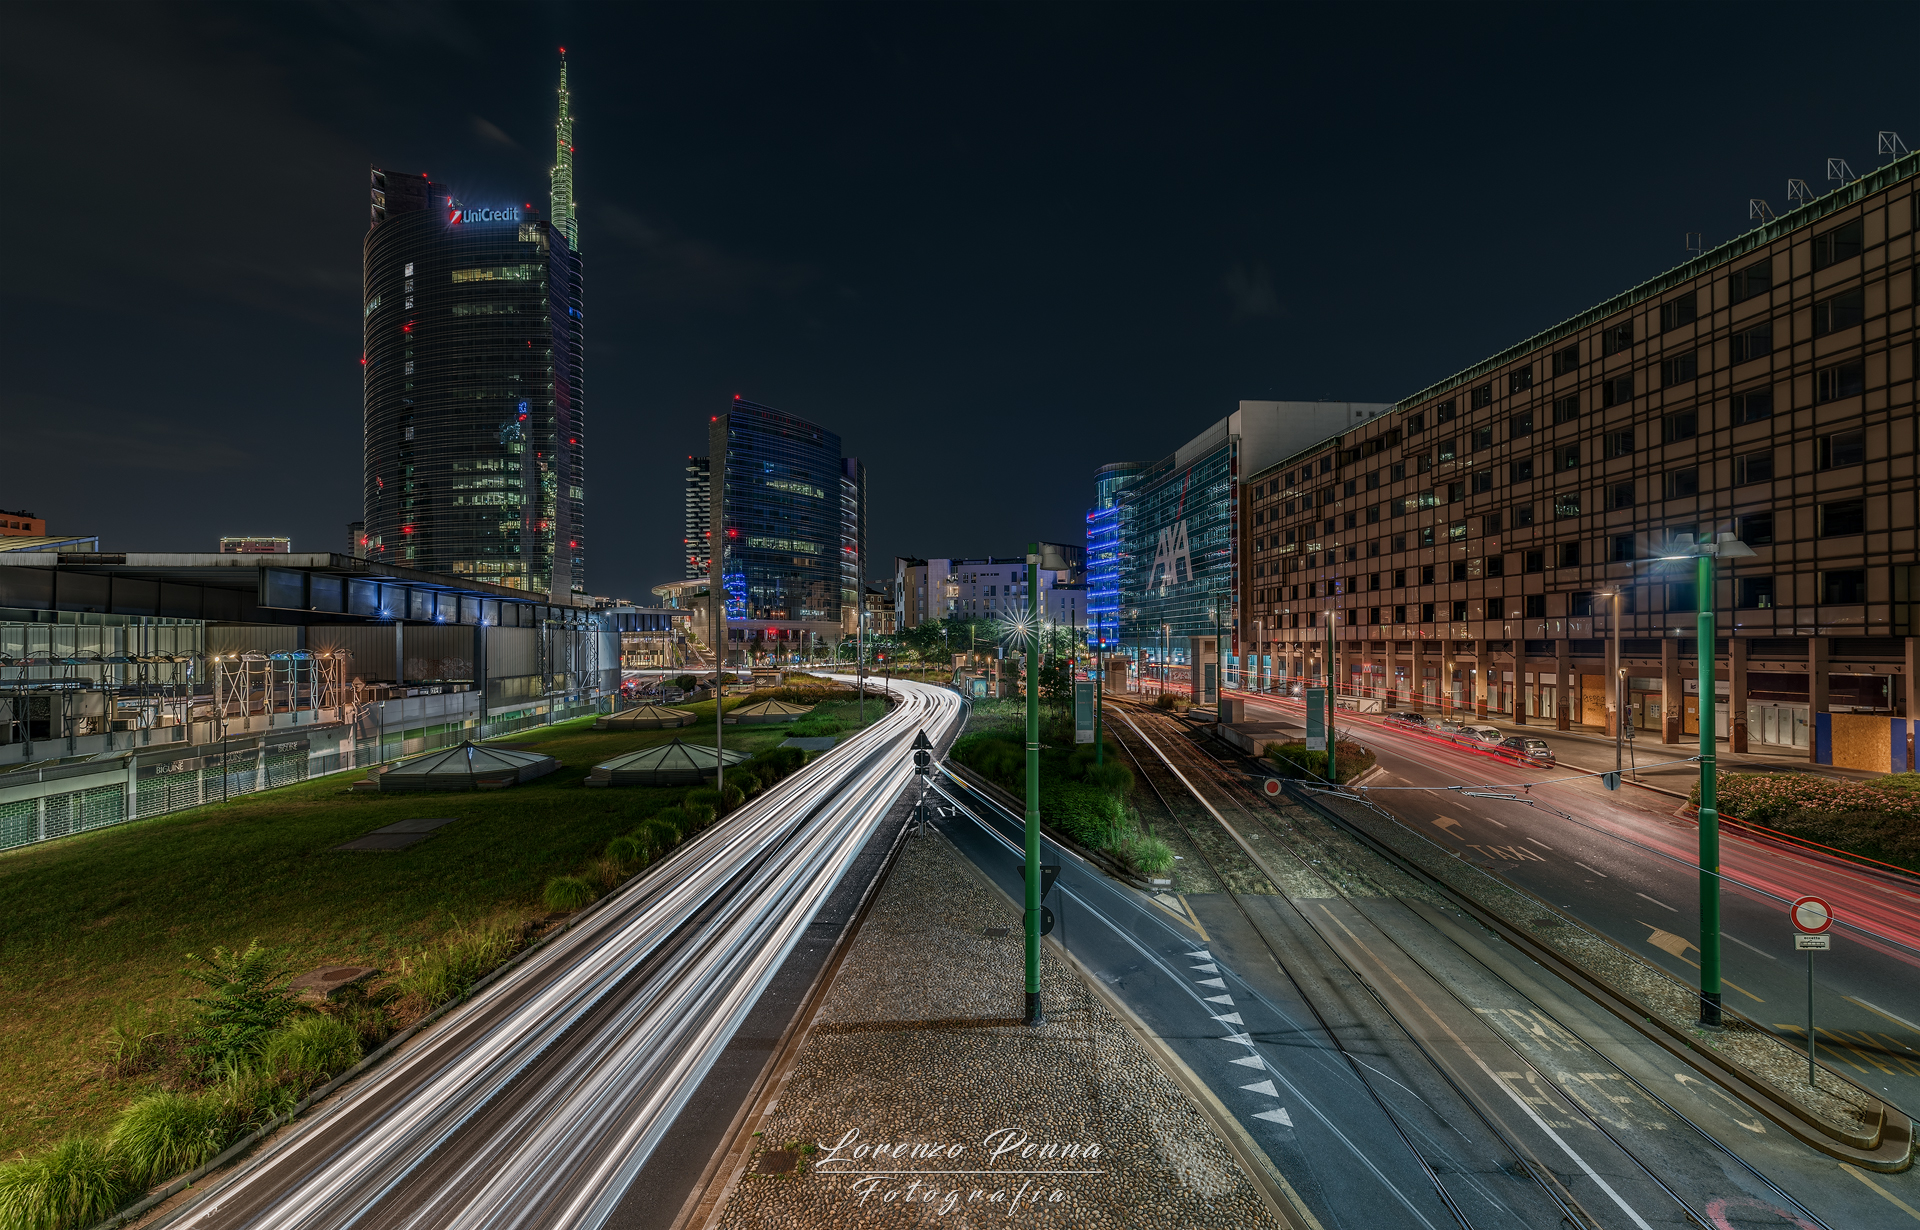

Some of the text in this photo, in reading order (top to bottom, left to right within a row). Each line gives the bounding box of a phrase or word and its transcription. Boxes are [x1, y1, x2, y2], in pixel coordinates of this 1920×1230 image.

[463, 207, 519, 223] UniCredit
[1147, 519, 1194, 590] AXA
[156, 762, 184, 774] BIGUINE
[1465, 844, 1546, 861] TAXI
